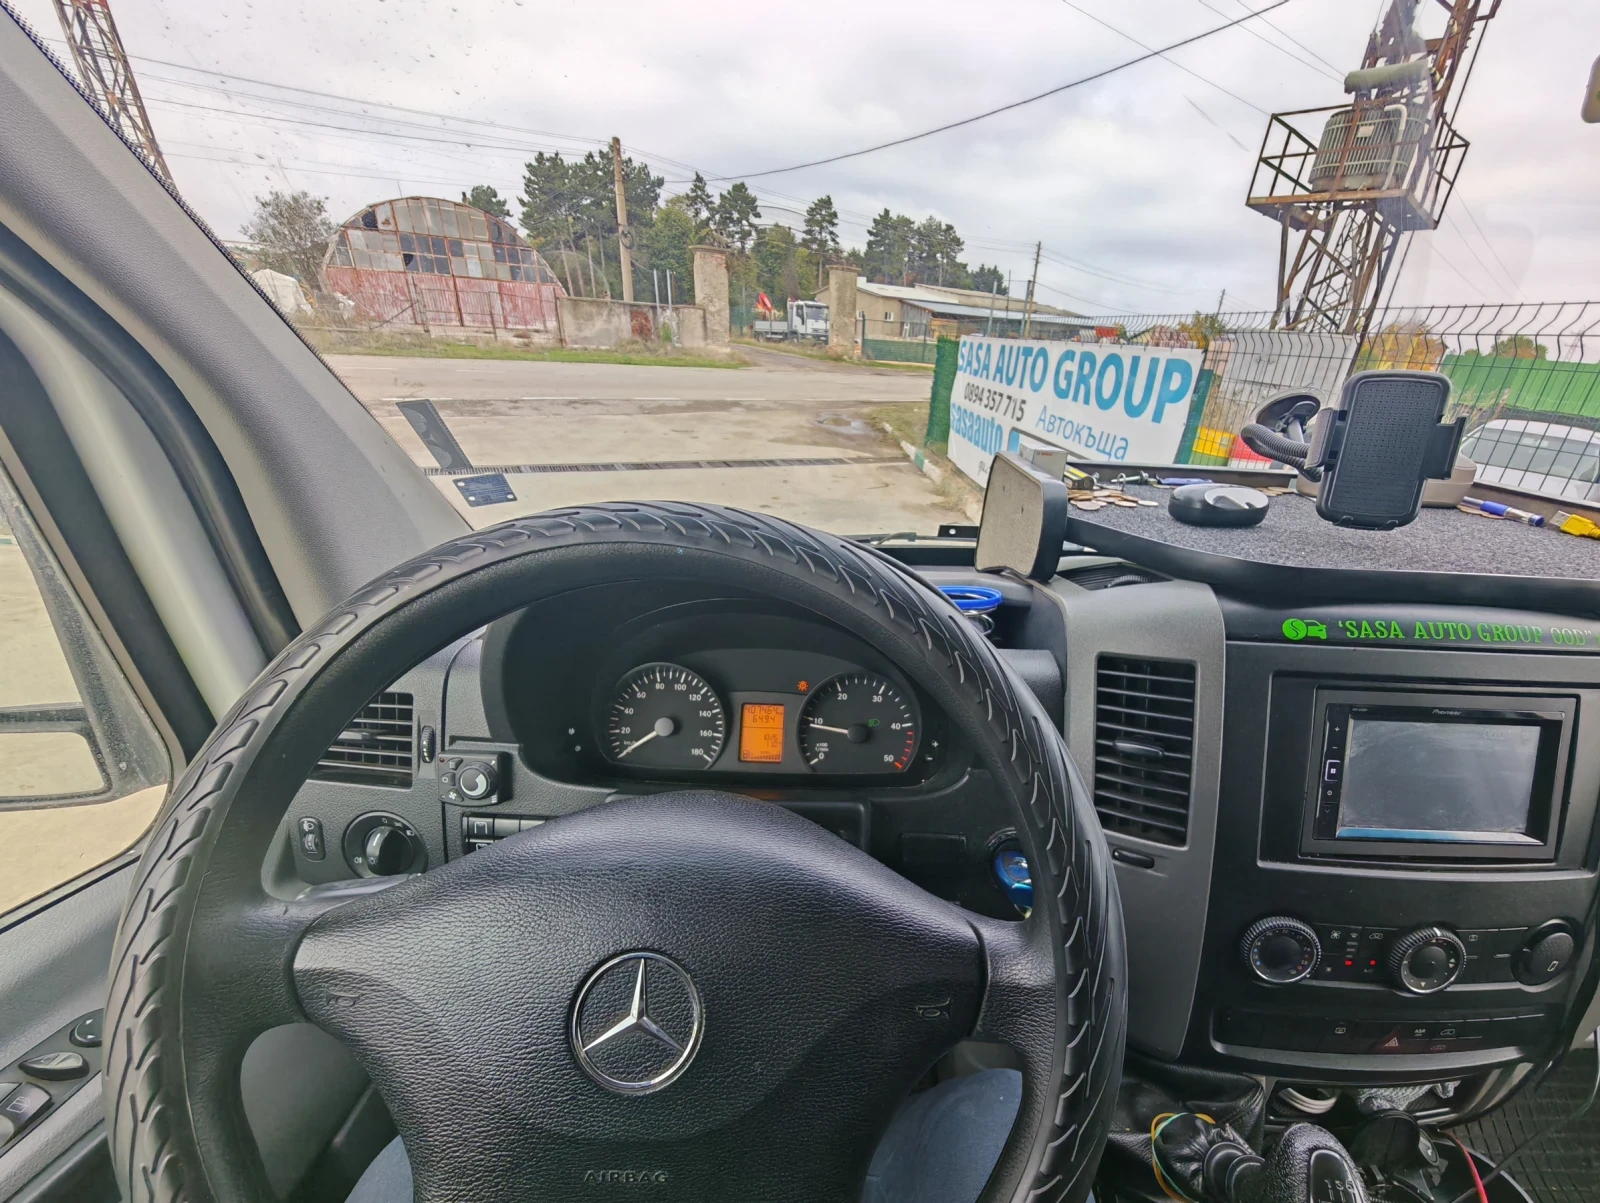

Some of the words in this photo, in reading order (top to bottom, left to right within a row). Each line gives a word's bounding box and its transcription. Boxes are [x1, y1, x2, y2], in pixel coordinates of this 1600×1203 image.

[958, 340, 990, 379] SASA
[992, 344, 1049, 393] AUTO
[1053, 349, 1193, 424] GROUP
[963, 382, 985, 407] 0894
[984, 388, 1004, 413] 357
[1003, 394, 1027, 422] 715
[952, 402, 1004, 457] sasaauto
[1035, 404, 1129, 462] Автокъща
[1413, 621, 1472, 641] AUTO
[1478, 622, 1543, 644] GROUP
[673, 683, 687, 691] 100
[688, 693, 702, 701] 120
[837, 693, 848, 701] 20
[872, 695, 883, 703] 30
[624, 707, 634, 715] 40
[698, 710, 712, 718] 140
[1432, 708, 1462, 717] Pioneer
[814, 717, 824, 725] 10
[620, 726, 631, 734] 20
[890, 722, 901, 730] 40
[699, 729, 713, 737] 160
[691, 748, 704, 756] 180
[818, 752, 825, 760] 0
[883, 754, 894, 762] 50
[583, 1169, 669, 1184] AIRBAG
